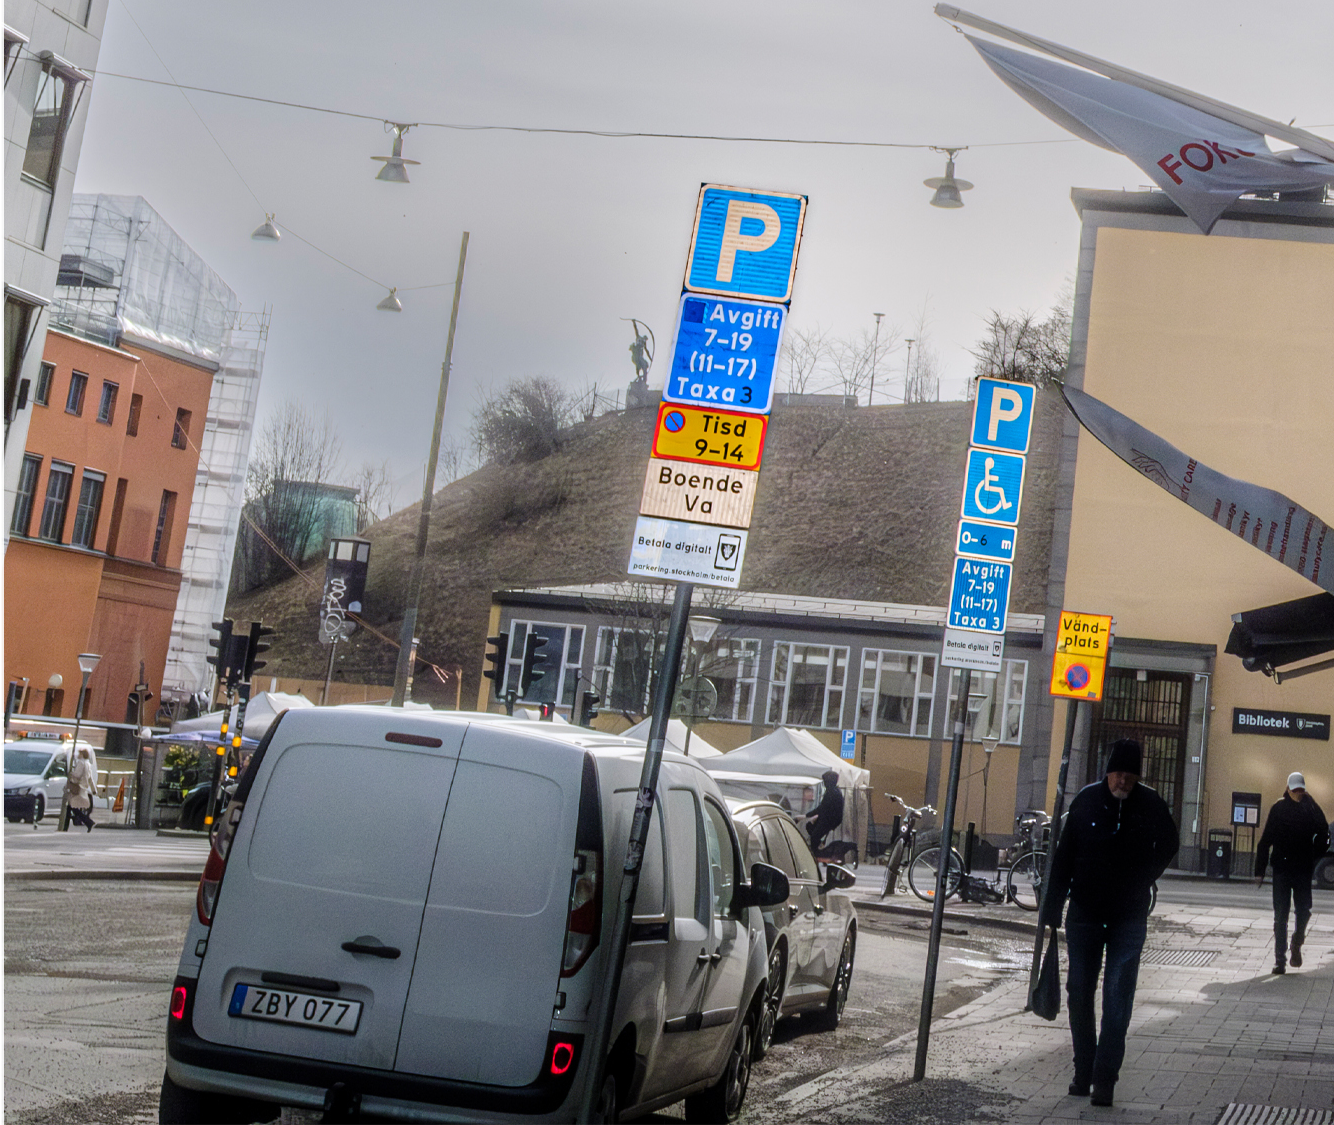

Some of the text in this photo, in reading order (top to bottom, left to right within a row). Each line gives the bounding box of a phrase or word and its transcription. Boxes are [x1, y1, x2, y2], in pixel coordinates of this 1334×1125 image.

[715, 199, 782, 283] P
[709, 303, 780, 330] Avgift
[704, 328, 753, 351] 7-19
[689, 350, 757, 380] (11-17)
[677, 376, 753, 404] Taxa 3
[987, 387, 1023, 441] P
[702, 414, 747, 437] Tisd
[695, 438, 744, 462] 9-14
[658, 466, 743, 494] Boende
[1183, 458, 1198, 484] CARE
[685, 494, 713, 514] Va
[638, 536, 712, 555] Betala digitalt
[1001, 539, 1012, 551] m
[961, 561, 1005, 580] Avgift
[967, 578, 995, 595] 7-19
[960, 594, 998, 613] (11-17)
[954, 611, 1000, 630] Taxa 3
[1063, 618, 1107, 634] Vänd-
[1064, 635, 1100, 649] plats
[1238, 713, 1290, 728] Bibliotek
[845, 731, 854, 743] P
[251, 990, 351, 1026] ZBY 077
